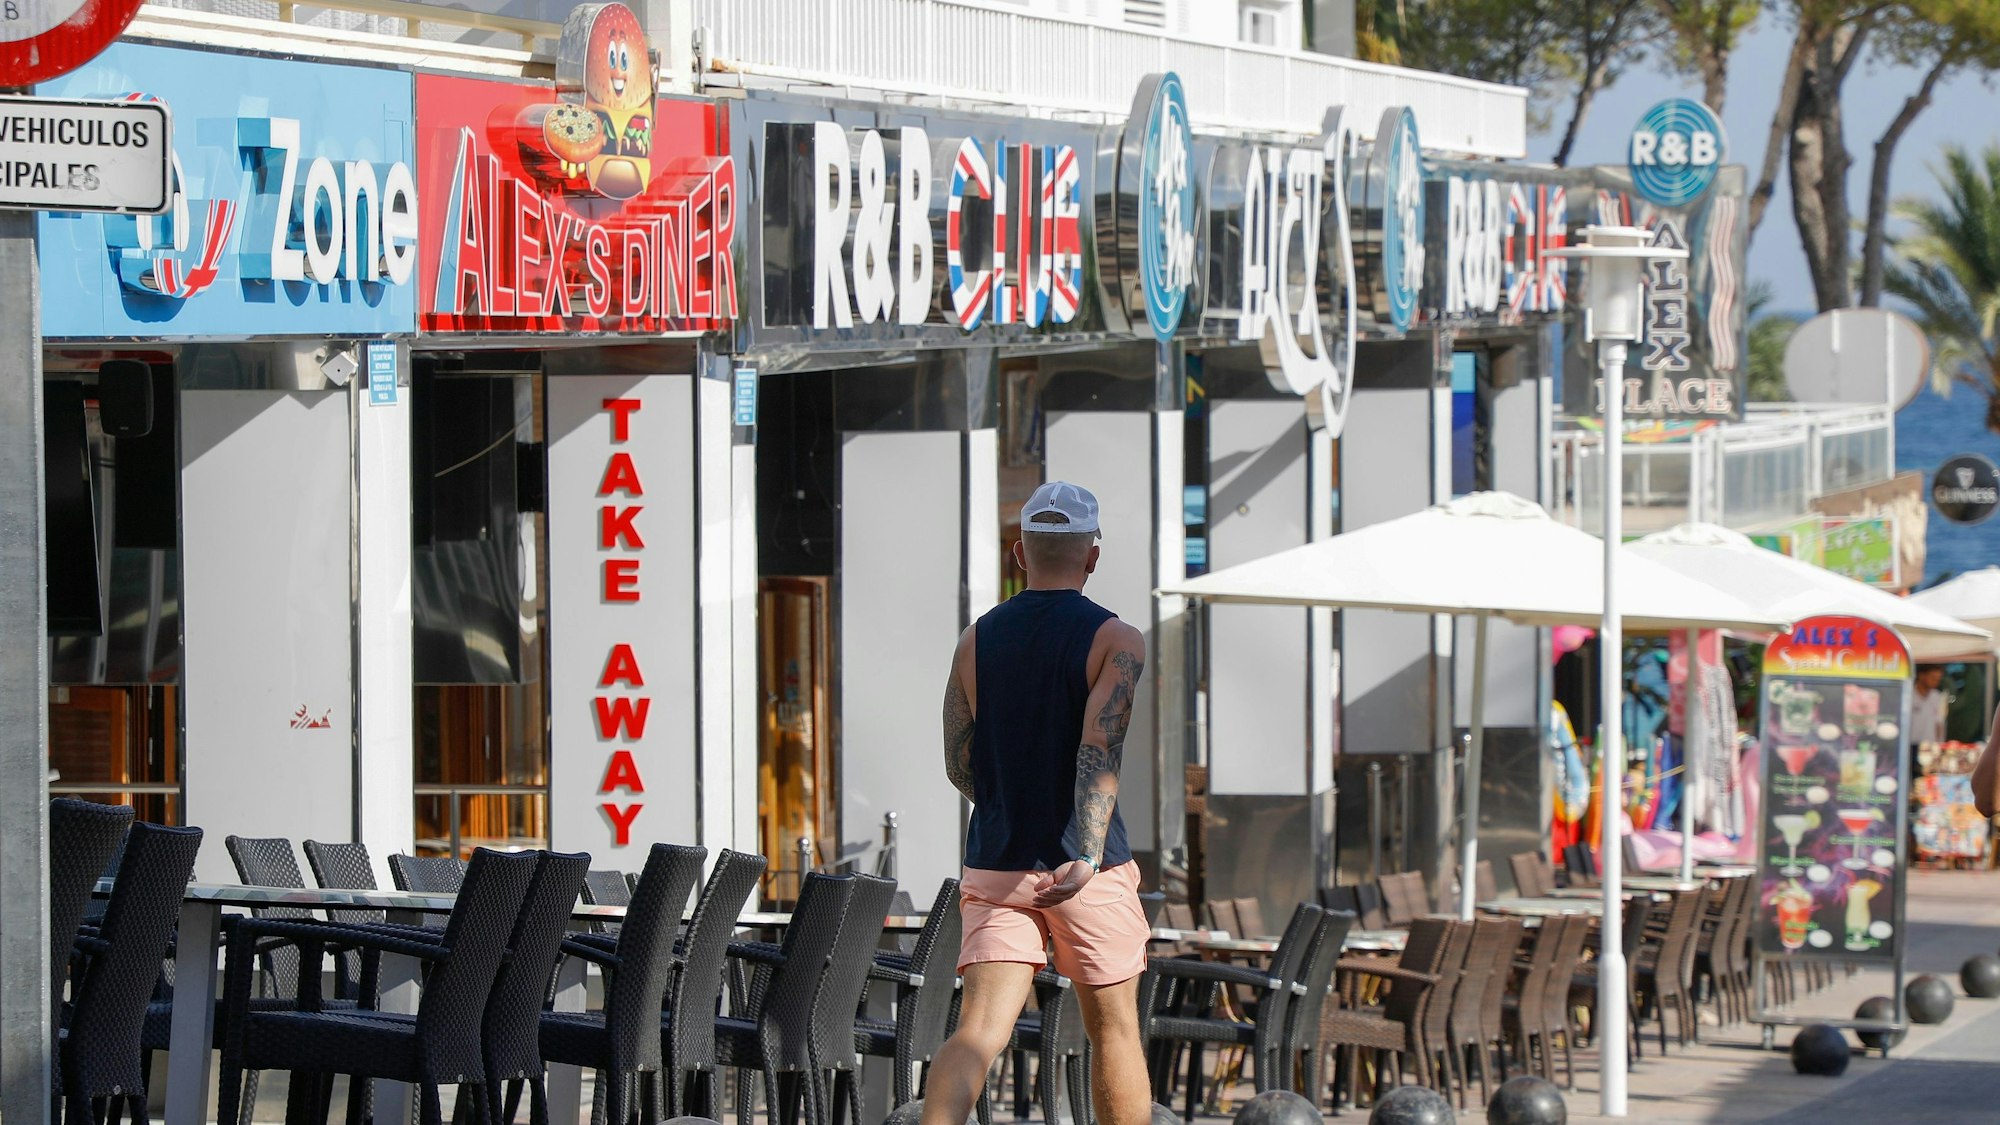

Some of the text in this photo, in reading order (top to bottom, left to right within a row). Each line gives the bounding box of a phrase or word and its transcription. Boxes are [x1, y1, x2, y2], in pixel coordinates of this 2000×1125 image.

[0, 160, 101, 192] IPALES
[268, 117, 418, 286] Zone
[453, 126, 739, 320] ALEX'S DINER
[813, 120, 933, 329] R&B
[946, 136, 1083, 331] CLUB
[1631, 131, 1719, 166] R&B
[1446, 176, 1500, 312] R&B
[1643, 219, 1690, 371] ALEX
[600, 399, 646, 602] TAKE
[595, 644, 650, 845] AWAY
